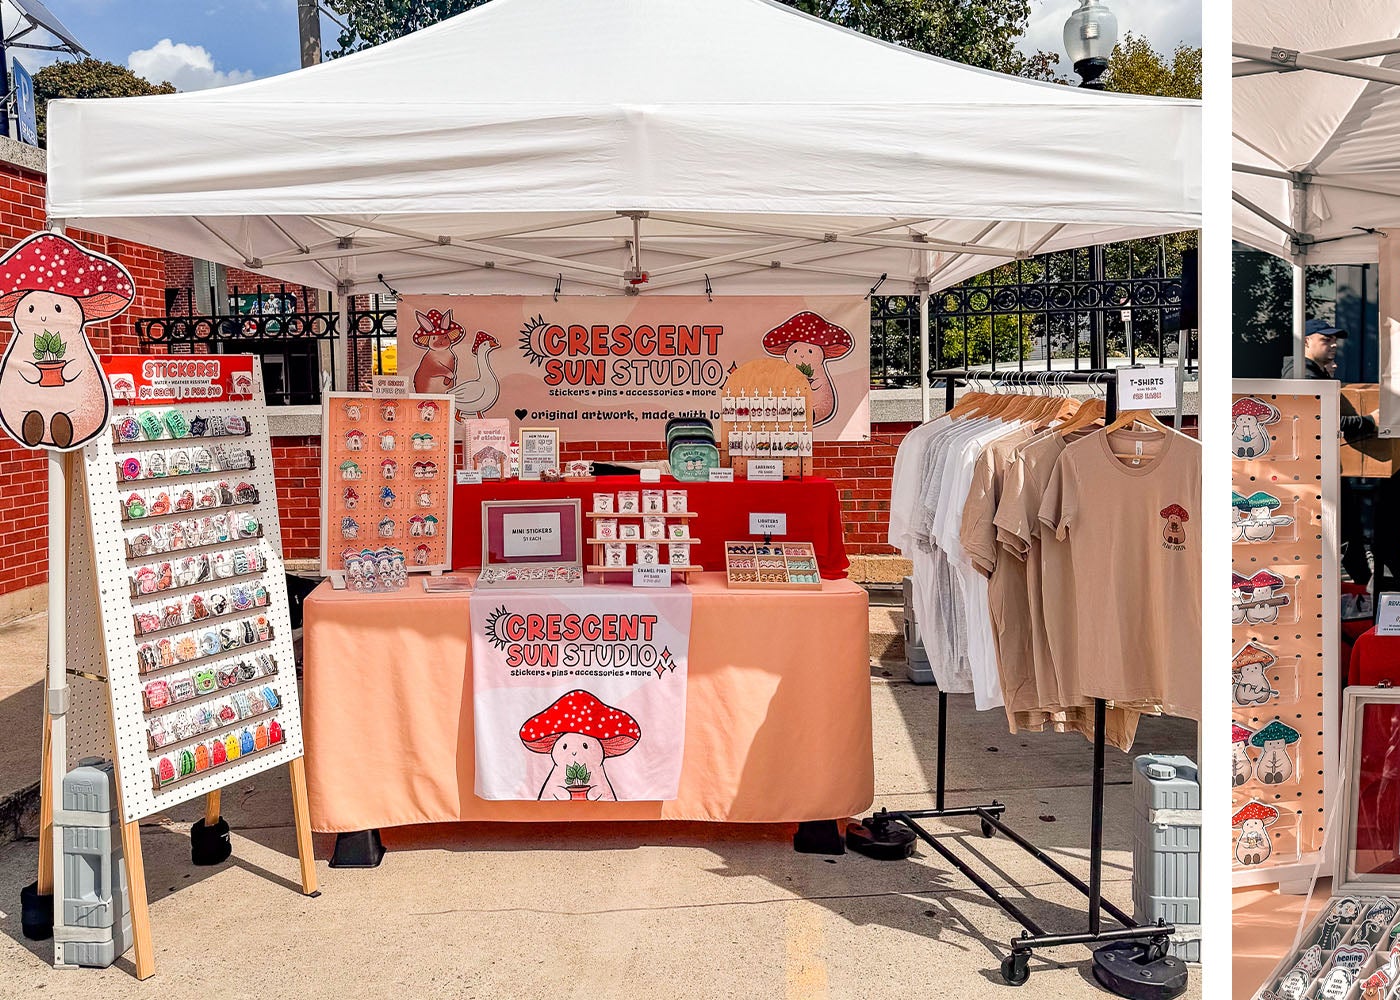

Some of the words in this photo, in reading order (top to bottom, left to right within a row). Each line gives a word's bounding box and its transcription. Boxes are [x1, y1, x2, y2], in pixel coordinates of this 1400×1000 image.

[544, 325, 723, 356] CRESCENT
[545, 359, 606, 386] SUN
[611, 359, 723, 386] STUDIO
[1130, 378, 1164, 386] T-SHIRTS
[549, 388, 590, 397] stickers
[597, 389, 618, 399] pins
[625, 388, 684, 397] accessories
[691, 389, 717, 397] more
[531, 410, 578, 422] original
[582, 410, 639, 422] artwork,
[642, 410, 675, 420] made
[506, 614, 657, 641] CRESCENT
[506, 644, 559, 668] SUN
[563, 643, 657, 668] STUDIO
[510, 669, 546, 677] stickers
[551, 669, 569, 678] pins
[574, 669, 624, 677] accessories
[1337, 953, 1363, 962] healing
